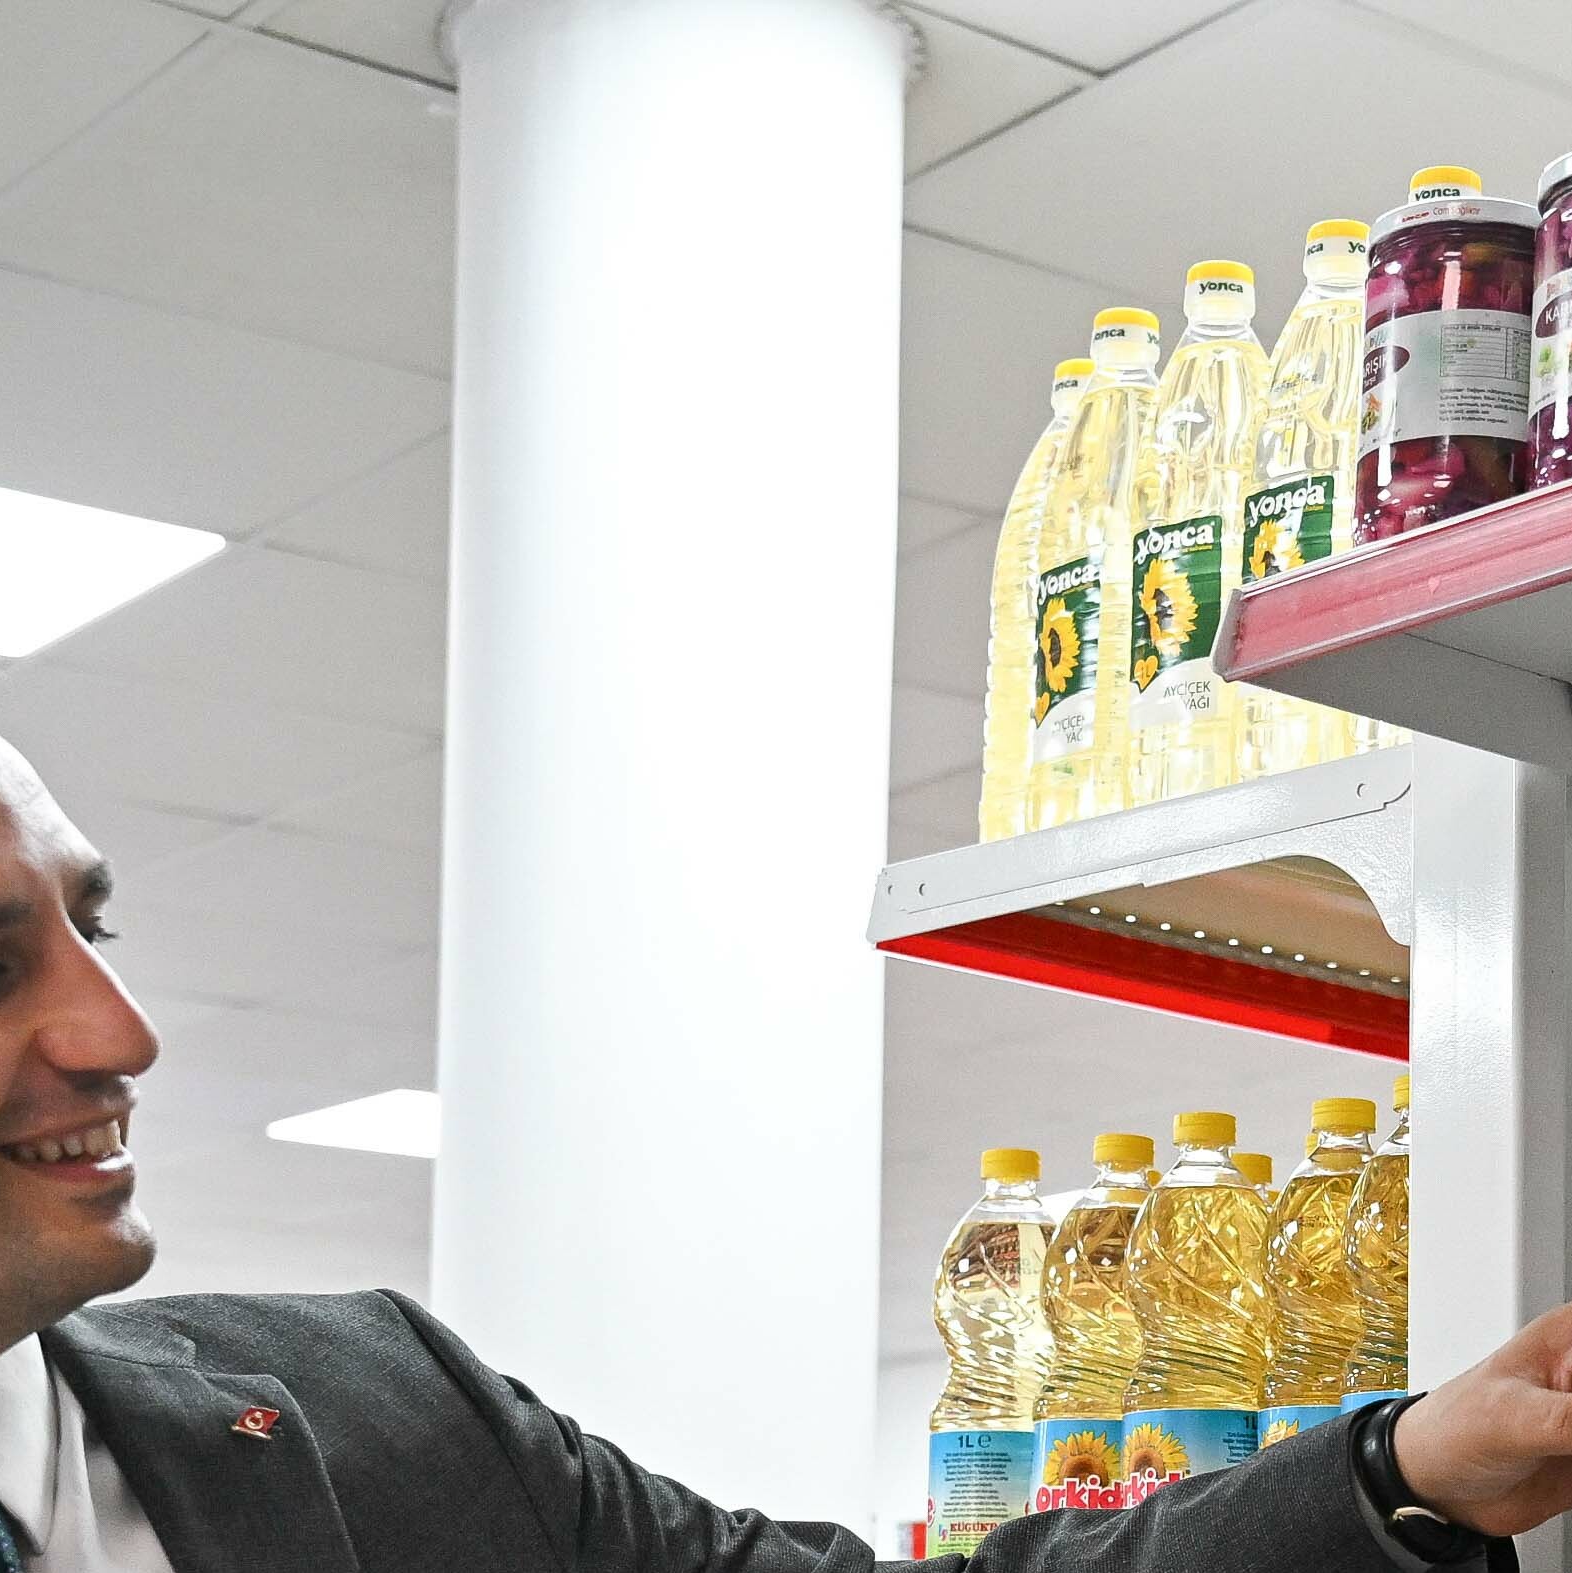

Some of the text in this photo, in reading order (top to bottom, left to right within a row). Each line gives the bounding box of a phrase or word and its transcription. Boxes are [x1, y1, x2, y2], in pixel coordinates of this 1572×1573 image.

[1415, 187, 1461, 200] yonca
[1199, 280, 1244, 295] yonca
[1094, 327, 1125, 342] onca
[1249, 483, 1326, 527] yonca
[1134, 522, 1215, 564] yonca
[1038, 562, 1099, 605] yonca
[1035, 1475, 1124, 1513] orkid
